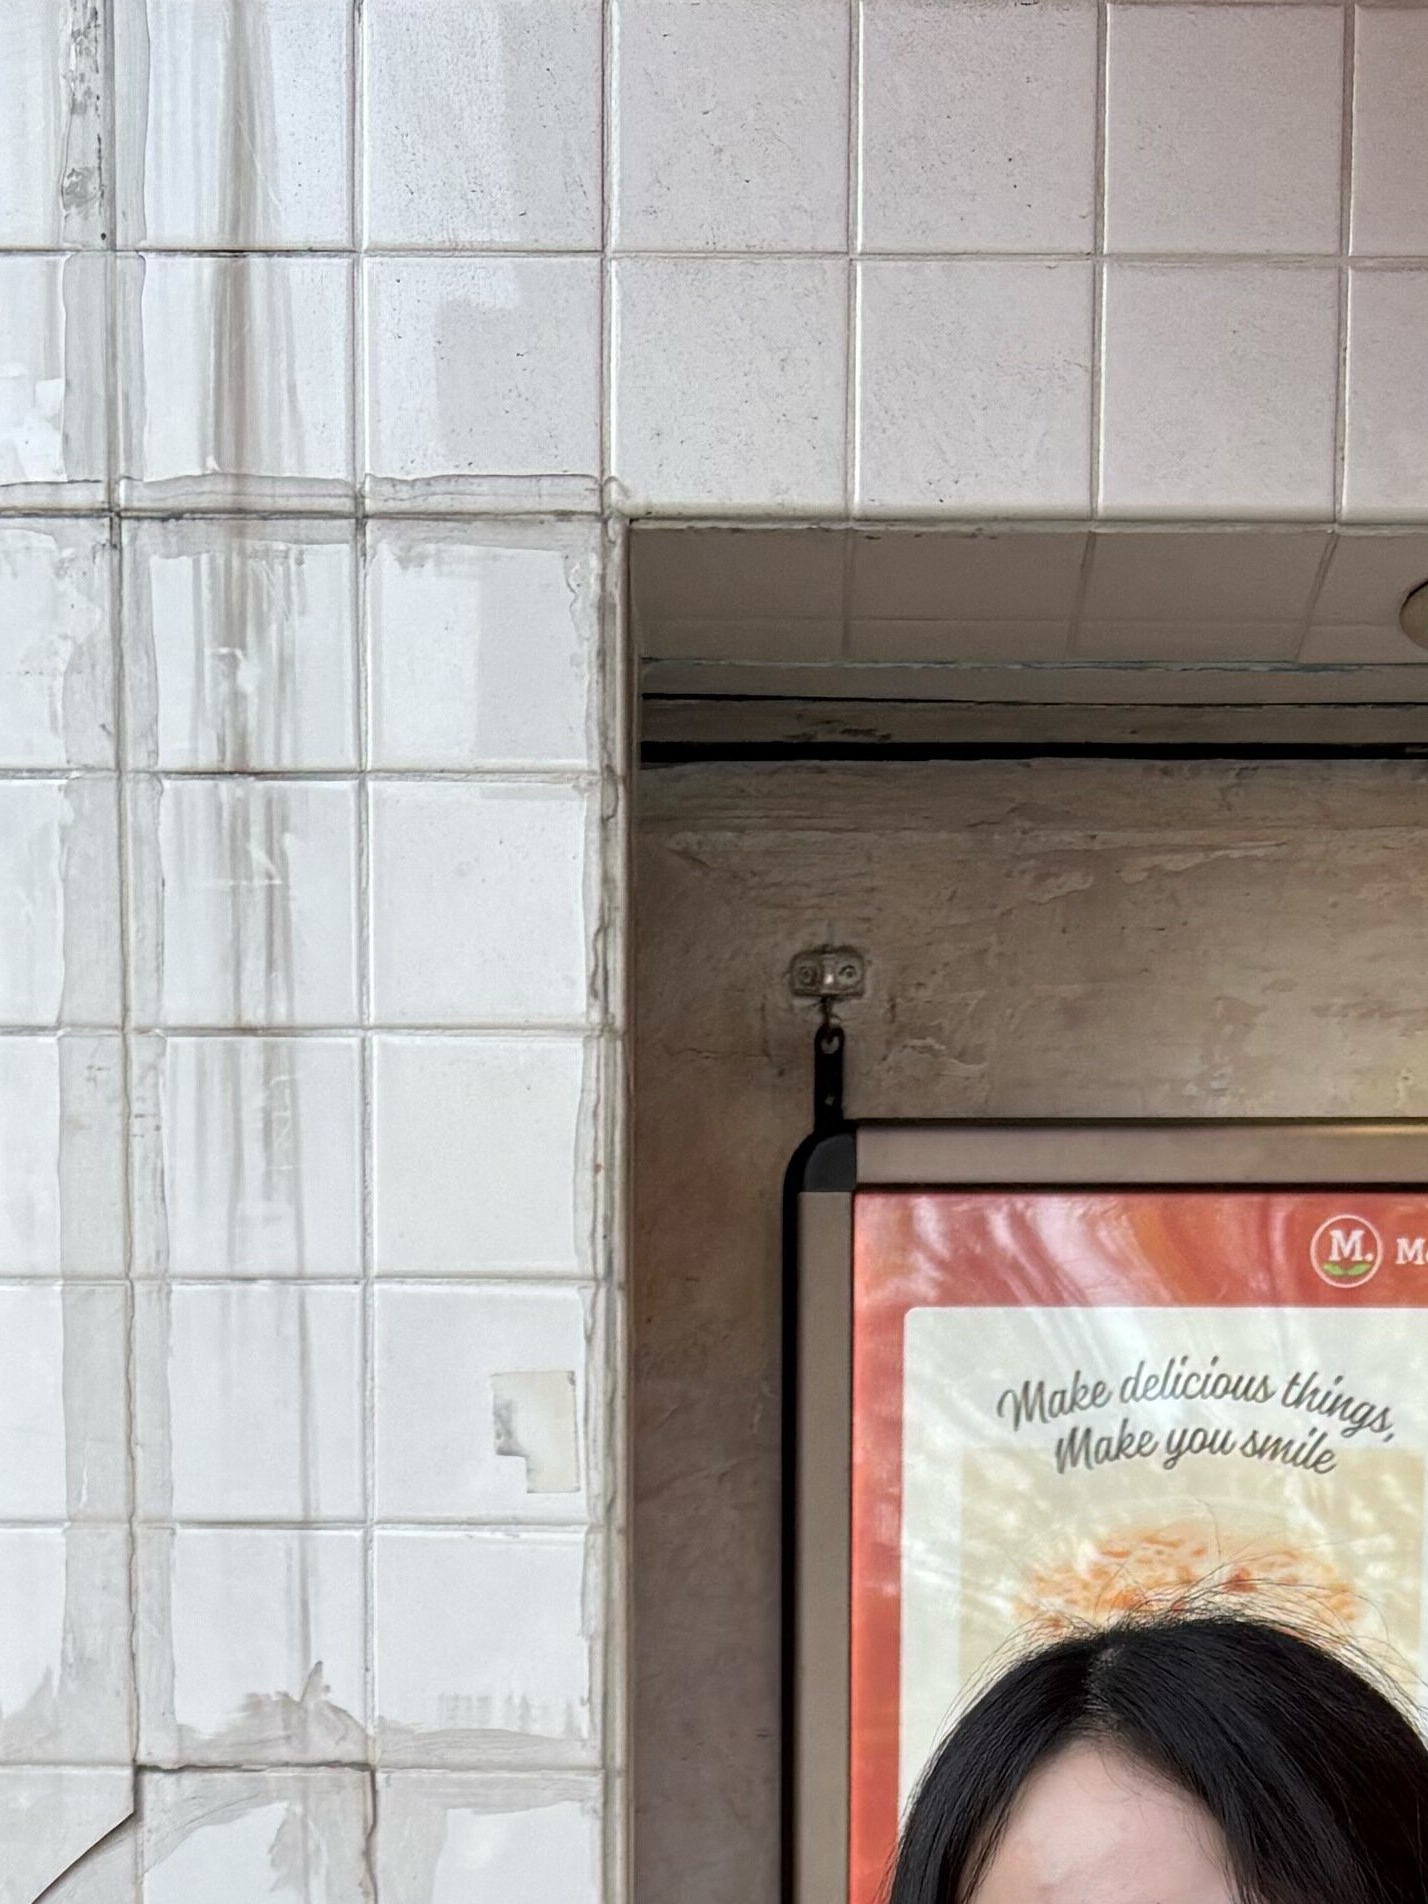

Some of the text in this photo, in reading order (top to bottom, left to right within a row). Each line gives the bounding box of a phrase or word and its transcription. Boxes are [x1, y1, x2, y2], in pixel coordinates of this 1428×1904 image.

[997, 1354, 1398, 1444] Make delicious things,
[1055, 1418, 1338, 1475] Make you smile
